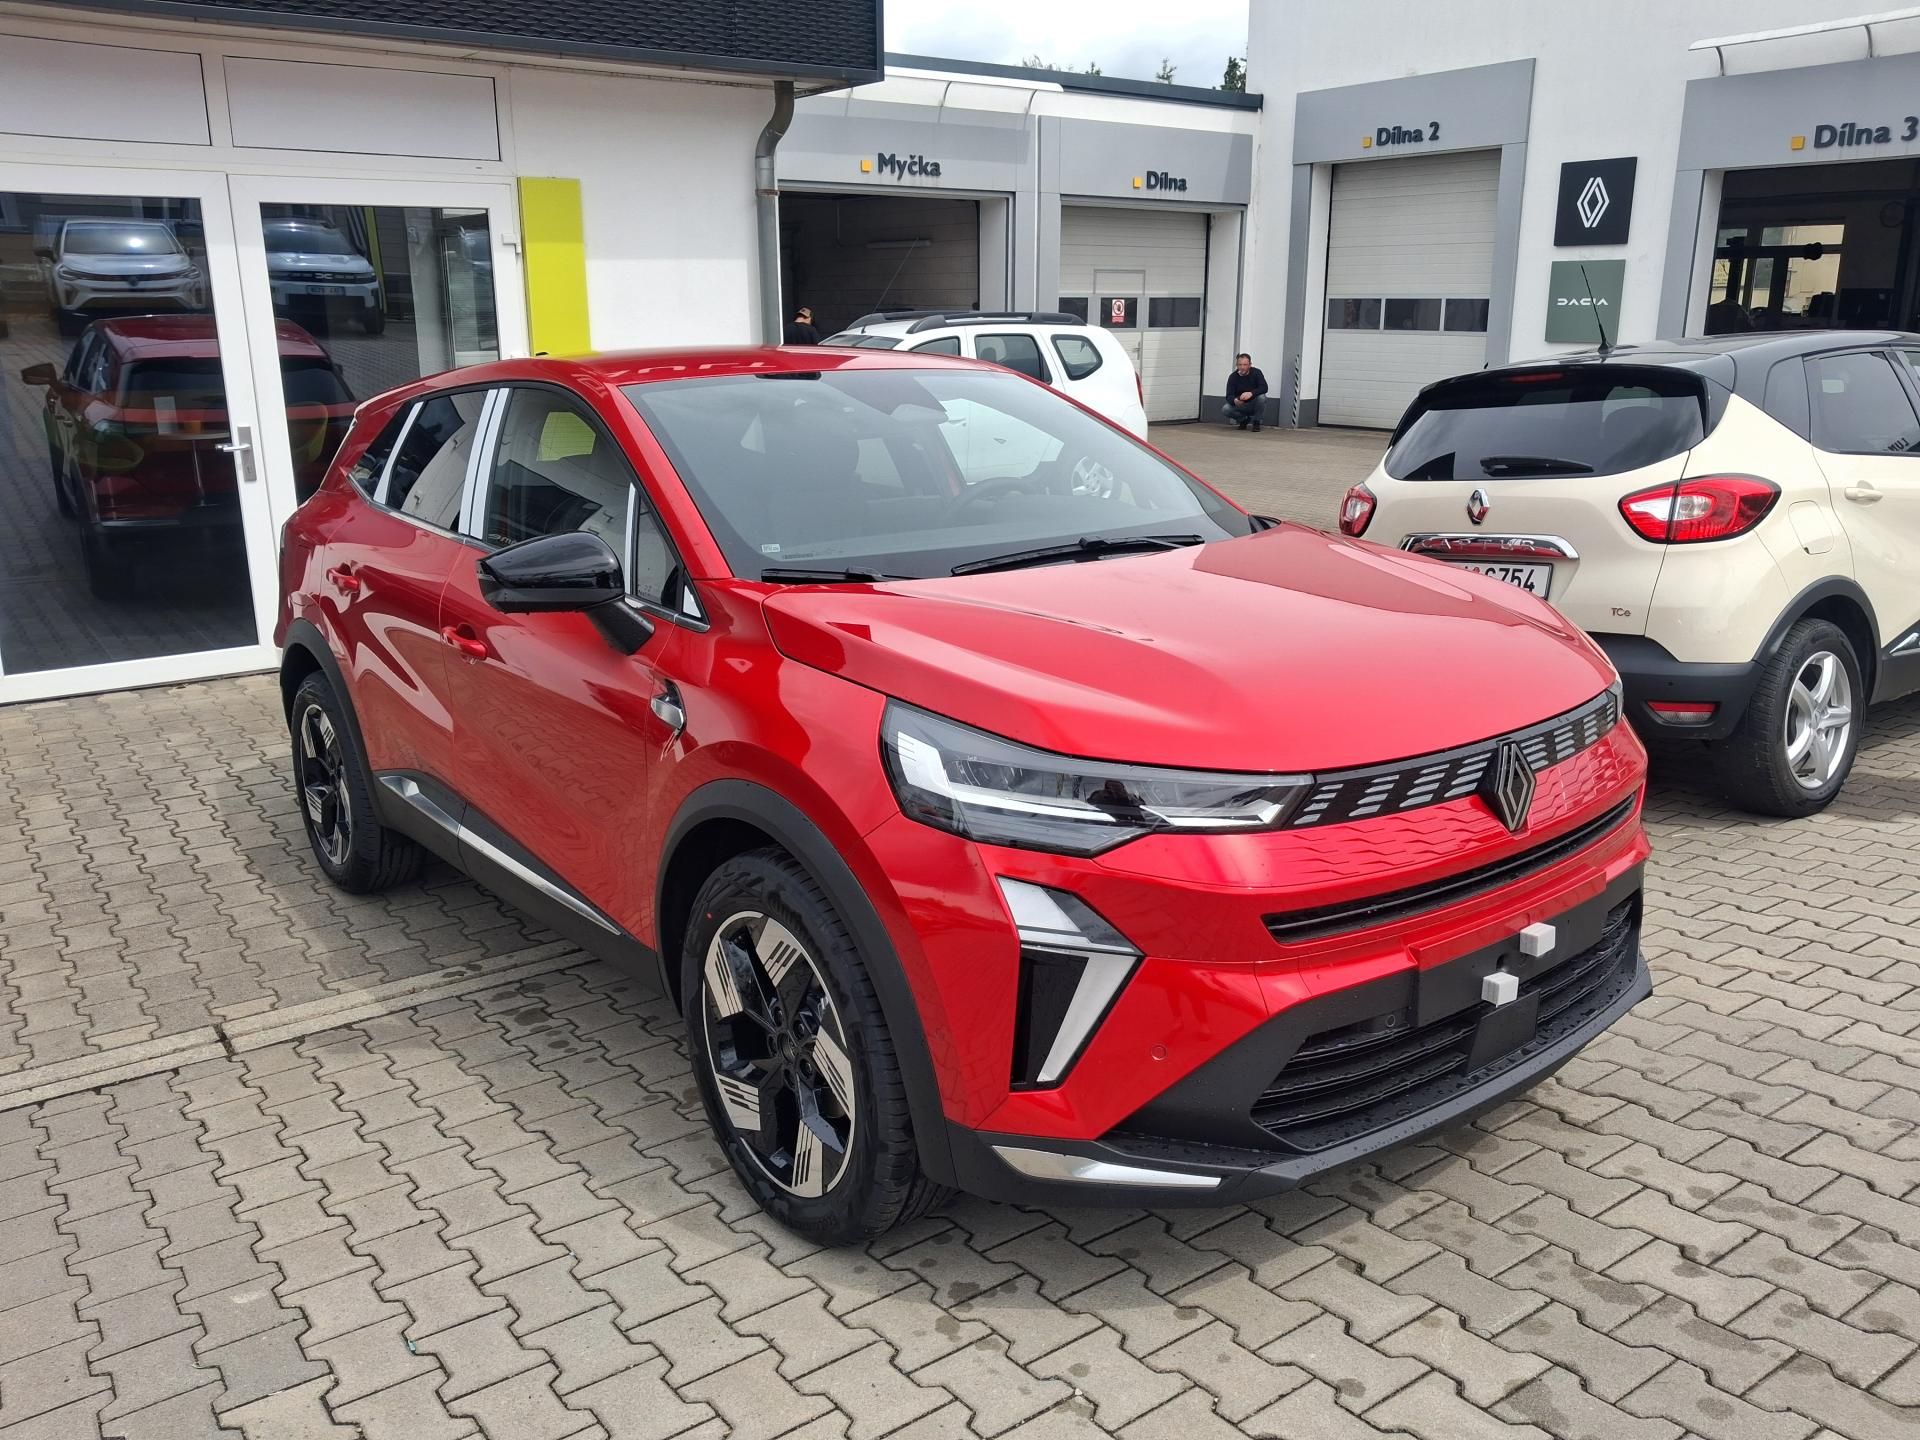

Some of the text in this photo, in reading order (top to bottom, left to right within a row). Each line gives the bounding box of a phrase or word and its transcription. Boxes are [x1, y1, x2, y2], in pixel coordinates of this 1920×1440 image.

[1376, 121, 1440, 146] Dílna 2
[1814, 116, 1919, 149] Dílna 3
[877, 152, 942, 181] Myčka
[1146, 170, 1188, 192] Dílna
[1556, 297, 1609, 306] DACIA
[1421, 537, 1536, 552] CAPTUR
[1611, 607, 1632, 617] TCe
